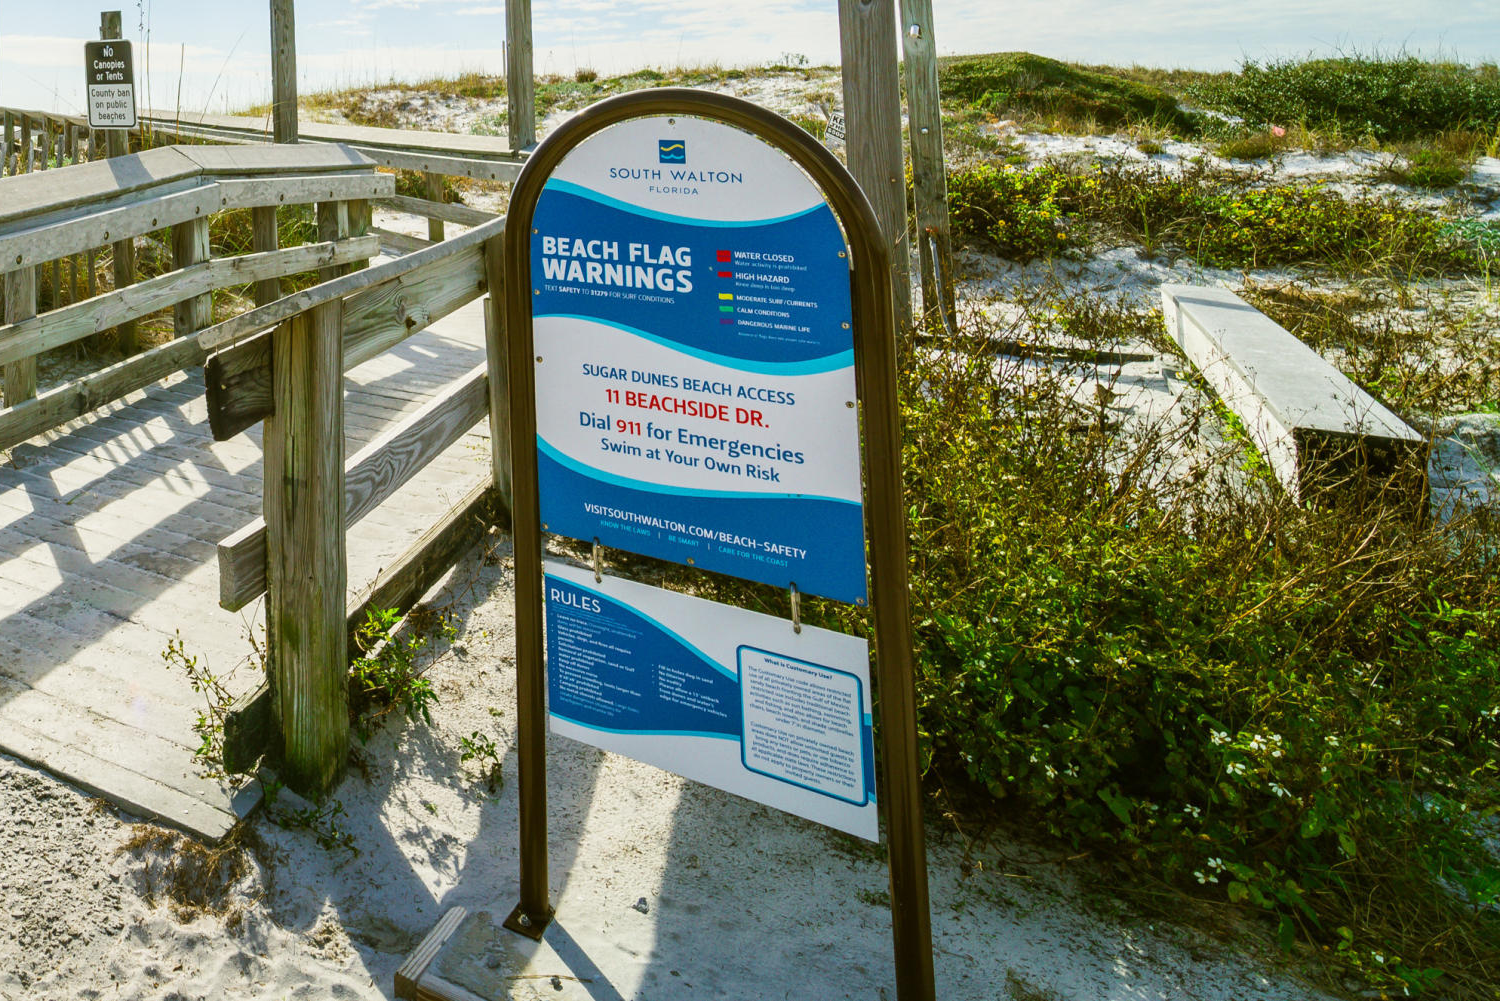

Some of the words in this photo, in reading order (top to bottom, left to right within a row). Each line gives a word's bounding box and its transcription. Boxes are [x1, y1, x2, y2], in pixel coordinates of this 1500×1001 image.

[103, 48, 113, 57] NO
[94, 60, 125, 70] Canopies
[106, 72, 124, 80] Tents
[91, 89, 115, 98] County
[118, 89, 130, 97] ban
[107, 100, 127, 109] public
[833, 116, 844, 125] KE
[609, 167, 661, 180] SOUTH
[670, 170, 743, 184] WALTON
[649, 186, 699, 195] FLORIDA
[543, 236, 619, 261] BEACH
[629, 243, 692, 267] FLAG
[734, 251, 760, 260] WATER
[763, 253, 794, 263] CLOSED
[542, 257, 693, 293] WARNINGS
[735, 272, 755, 281] HIGH
[757, 274, 790, 284] HAZARD
[544, 284, 558, 292] TEXT
[558, 286, 580, 295] SAFETY
[590, 289, 608, 297] 31279
[638, 294, 675, 304] CONDITIONS
[737, 295, 767, 304] MODERATE
[754, 308, 790, 318] CONDITIONS
[738, 320, 772, 329] DANGEROUS
[774, 323, 796, 332] MARINE
[582, 363, 627, 381] SUGAR
[632, 370, 678, 389] DUNES
[683, 378, 732, 397] BEACH
[737, 385, 796, 406] ACCESS
[605, 389, 619, 404] 11
[625, 391, 730, 421] BEACHSIDE
[735, 408, 770, 429] DR.
[579, 411, 611, 430] Dial
[616, 419, 641, 436] 911
[647, 422, 672, 441] for
[678, 428, 805, 464] Emergencies
[601, 438, 641, 457] Swim
[646, 447, 661, 461] at
[665, 450, 700, 467] Your
[704, 457, 741, 475] Own
[746, 464, 780, 483] Risk
[584, 502, 807, 560] VISITSOUTHWALTON.COM/BEACH-SAFETY
[600, 520, 620, 530] KNOW
[621, 524, 632, 533] THE
[632, 526, 651, 537] LAWS
[668, 535, 677, 543] BE
[678, 537, 699, 548] SMART
[718, 546, 735, 556] CARE
[737, 549, 750, 559] FOR
[752, 552, 765, 562] THE
[766, 555, 788, 568] COAST
[551, 588, 601, 613] RULES
[764, 657, 779, 666] What
[786, 663, 816, 677] Customary
[818, 672, 832, 680] Use?
